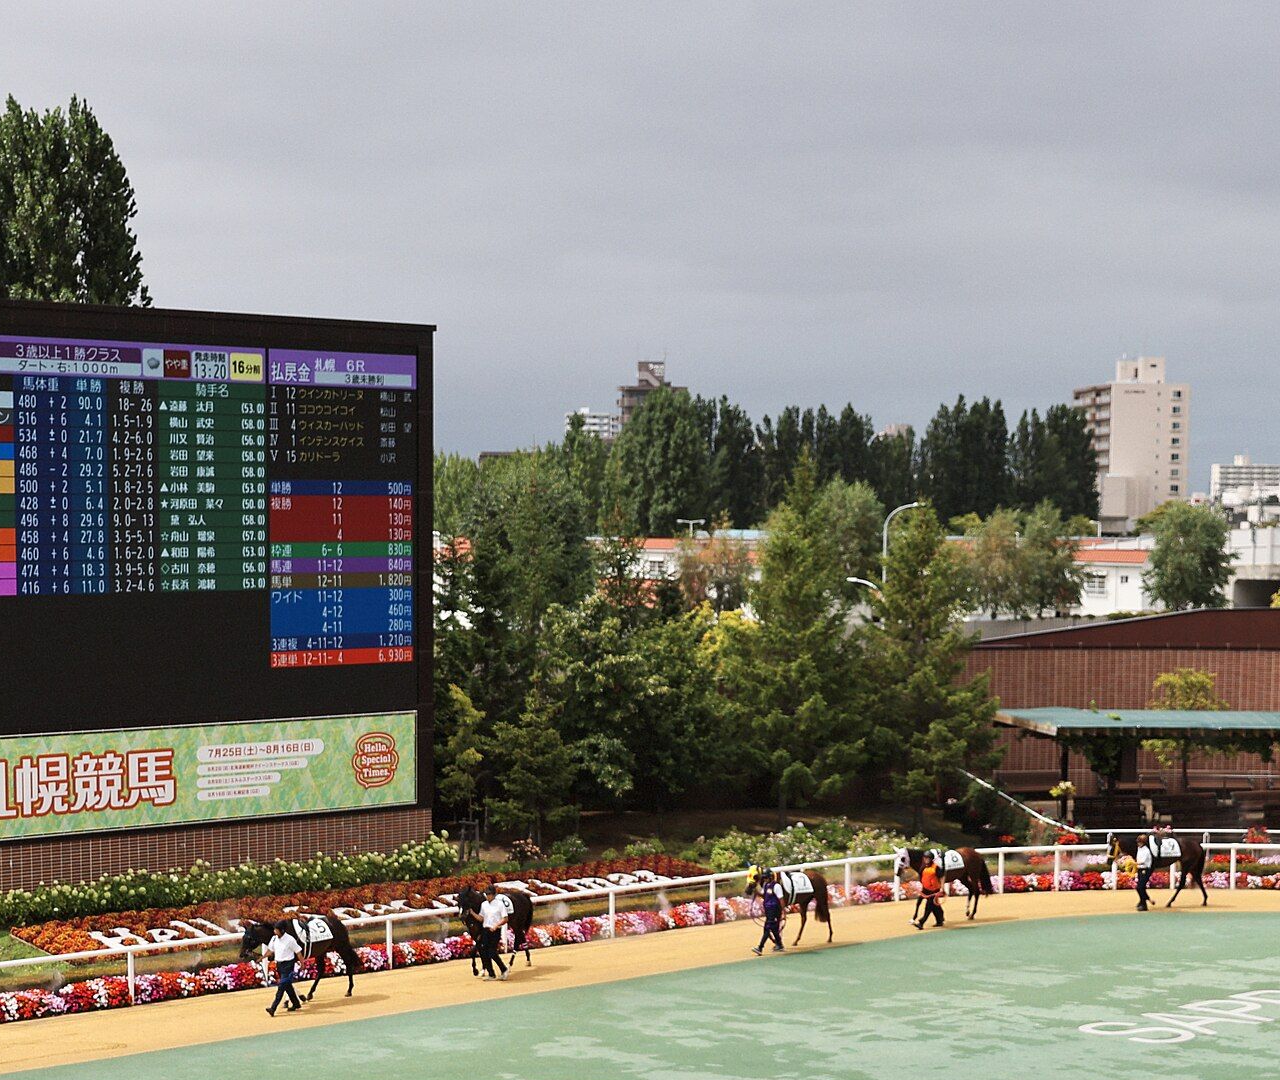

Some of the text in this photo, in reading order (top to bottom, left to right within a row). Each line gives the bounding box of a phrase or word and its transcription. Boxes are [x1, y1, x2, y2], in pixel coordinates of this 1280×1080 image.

[194, 362, 227, 380] 13:20
[315, 358, 365, 372] 札幌 6R
[271, 363, 310, 382] 払戻金
[23, 377, 60, 392] 馬体重
[76, 379, 101, 393] 単勝
[119, 380, 144, 395] 複勝
[196, 384, 229, 399] 騎手名
[286, 387, 296, 399] 12
[18, 395, 37, 408] 480
[286, 403, 295, 415] 11
[19, 411, 37, 425] 516
[291, 419, 296, 430] 4
[19, 429, 37, 442] 534
[19, 445, 38, 460] 468
[287, 450, 296, 463] 15
[19, 462, 38, 477] 486
[19, 479, 39, 494] 500
[270, 481, 412, 496] 単勝 12 500円
[20, 497, 39, 510] 428
[270, 497, 412, 511] 複勝 12 140円
[21, 513, 38, 527] 496
[333, 513, 412, 525] 11 130円
[21, 530, 39, 544] 458
[337, 528, 412, 541] 4 130円
[21, 547, 39, 560] 460
[387, 542, 412, 557] 830円
[21, 564, 39, 577] 474
[270, 557, 412, 573] 馬連 11-12 840円
[22, 581, 40, 594] 416
[270, 575, 293, 589] 馬単
[318, 575, 341, 587] 12-11
[272, 588, 412, 604] ワイド 11-12 300円
[322, 603, 412, 618] 4-12 460円
[322, 618, 412, 633] 4-11 280円
[270, 637, 298, 651] 3連複
[307, 636, 343, 649] 4-11-12
[270, 653, 298, 667] 3連単
[364, 743, 389, 753] Hello,
[362, 755, 391, 765] Special
[362, 769, 390, 778] Times.
[316, 922, 326, 933] 5
